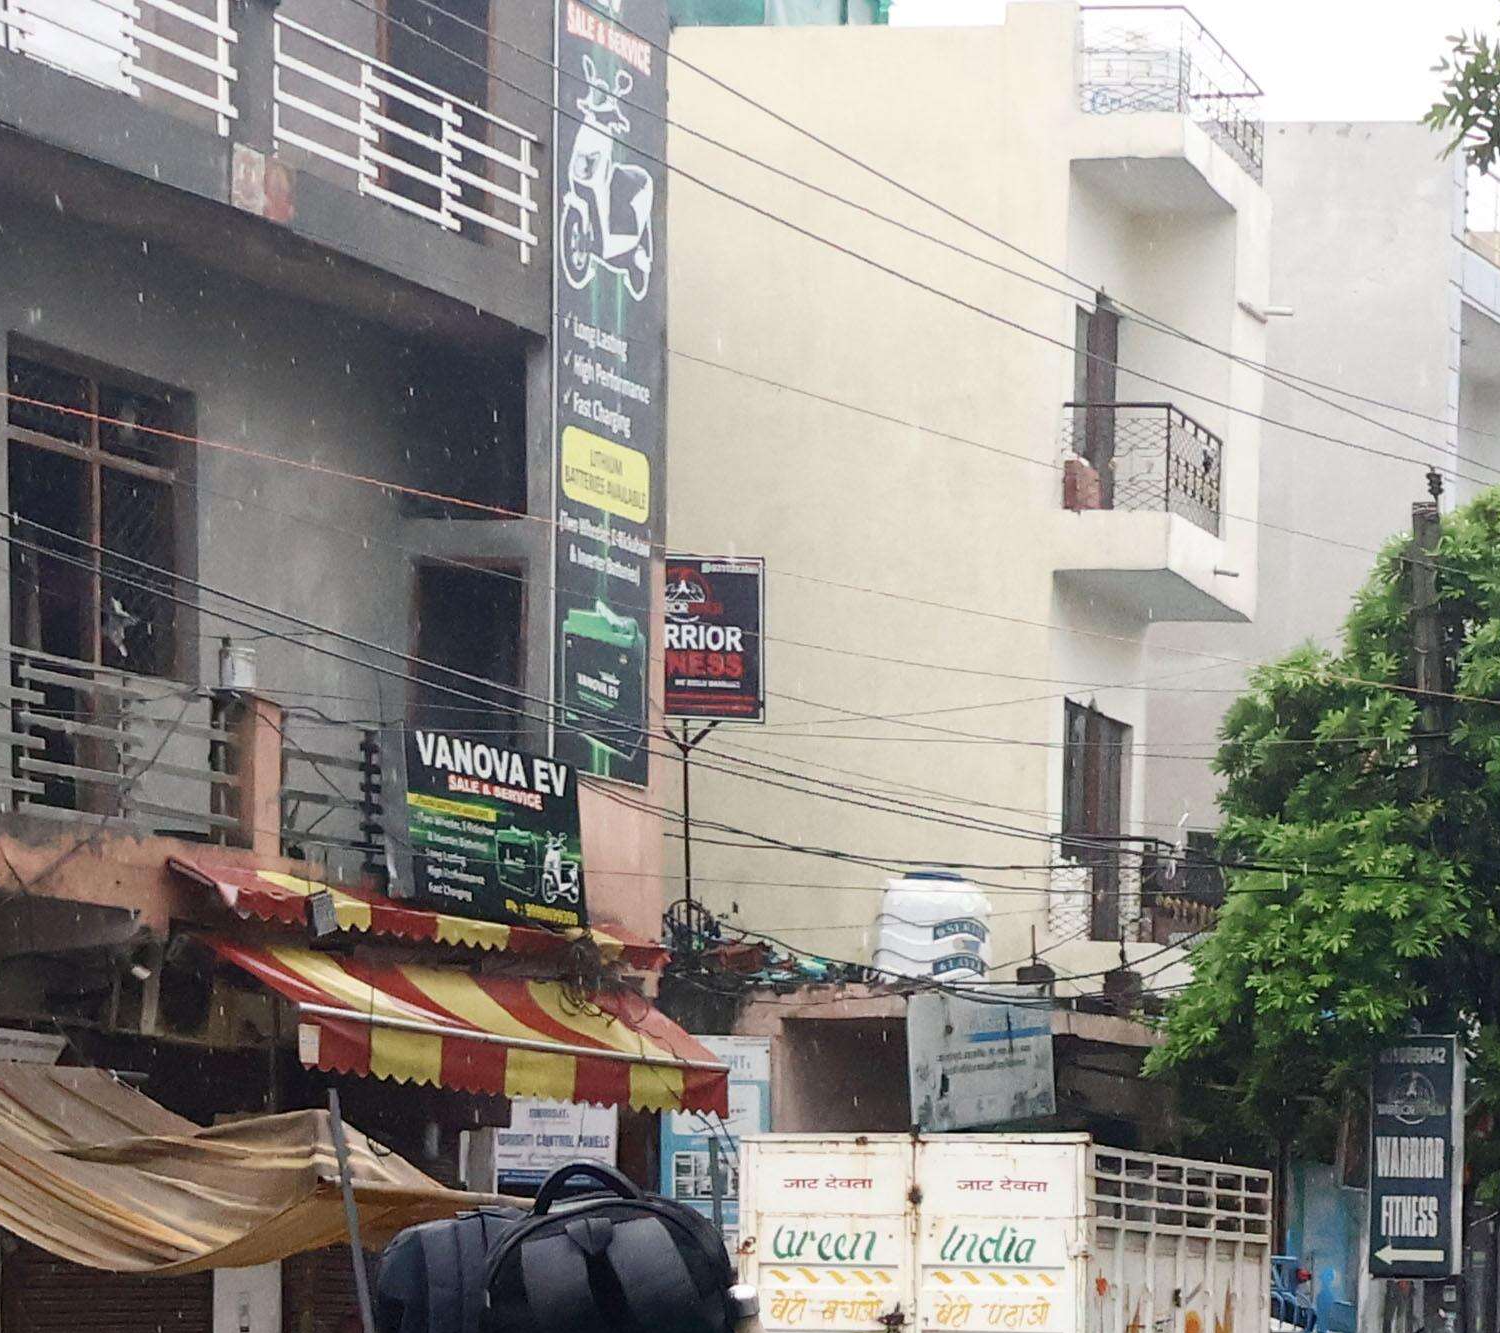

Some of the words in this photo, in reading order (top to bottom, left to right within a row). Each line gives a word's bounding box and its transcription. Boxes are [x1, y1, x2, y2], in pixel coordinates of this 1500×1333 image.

[665, 625, 744, 652] RRIOR
[666, 652, 745, 678] NESS
[415, 730, 528, 788] VANOVA
[532, 758, 567, 797] EV
[448, 775, 480, 794] SALE
[494, 785, 544, 811] SERVICE
[1376, 1136, 1445, 1178] WARRIOR
[784, 1178, 818, 1190] जाट
[825, 1173, 874, 1190] देवता
[956, 1179, 993, 1192] जाट
[999, 1176, 1049, 1193] देवता
[1381, 1195, 1439, 1238] FITNESS
[940, 1224, 1037, 1263] India
[769, 1290, 808, 1325] बेटी
[932, 1293, 973, 1327] बेटी
